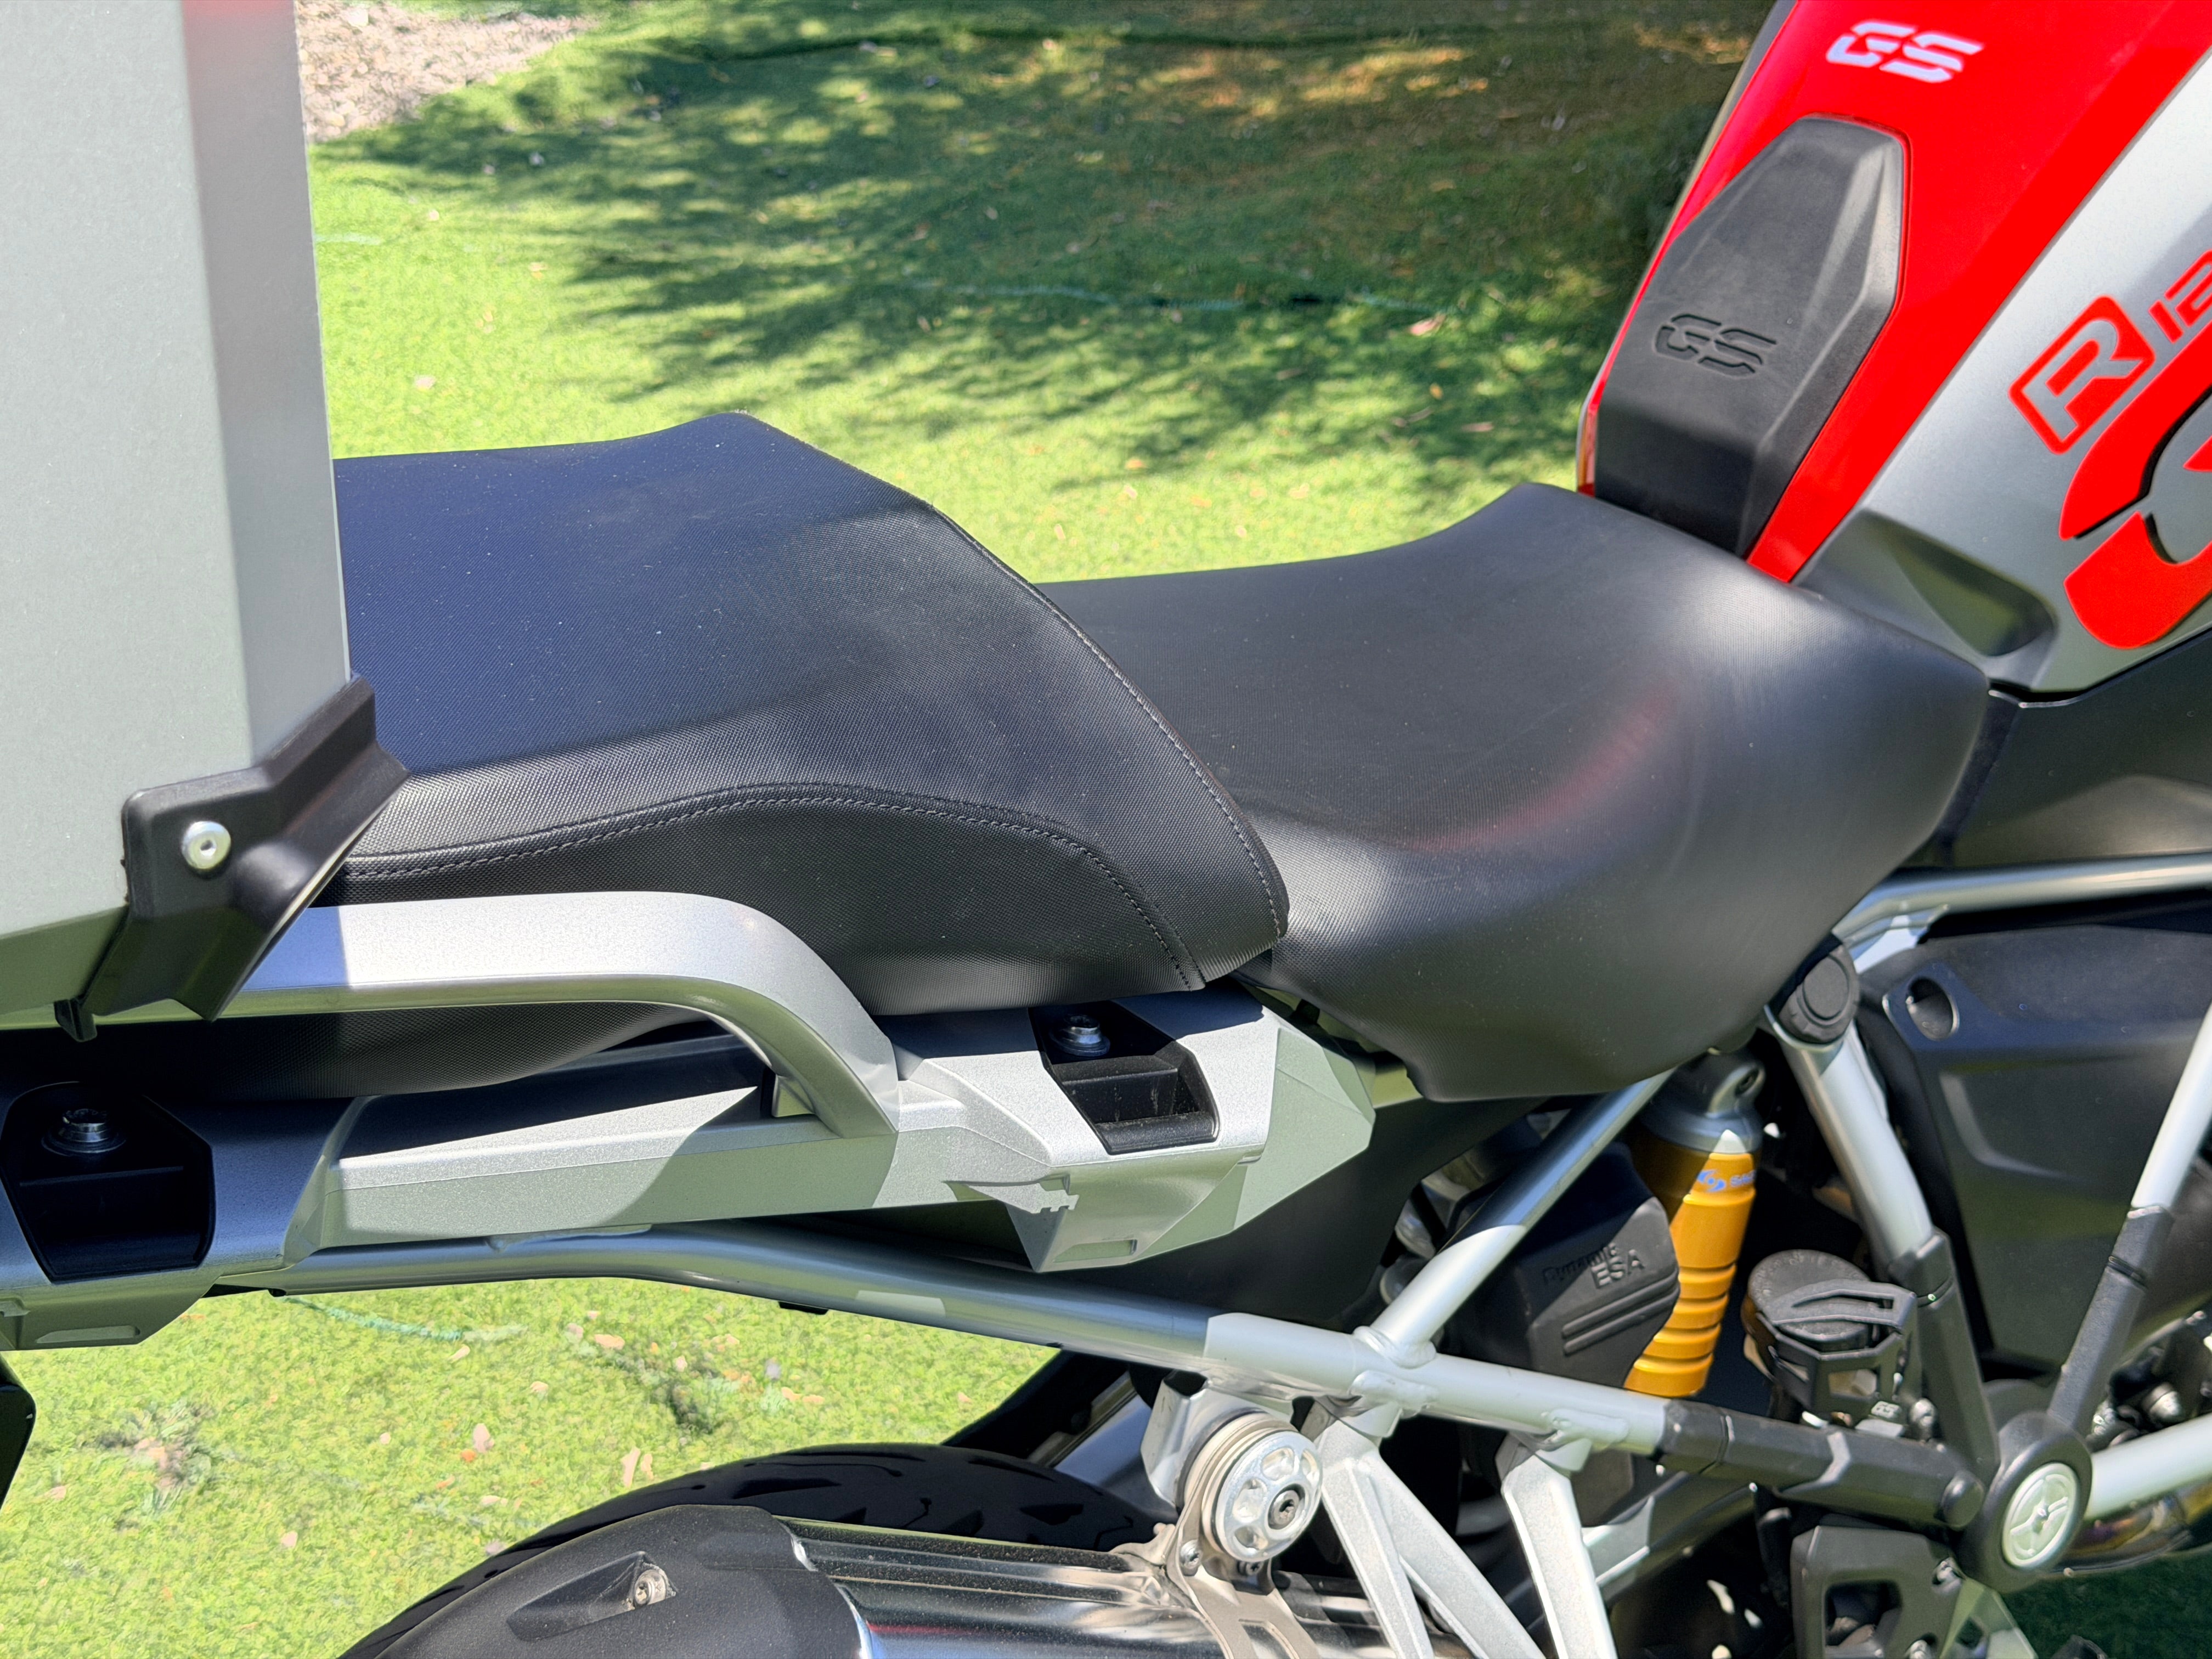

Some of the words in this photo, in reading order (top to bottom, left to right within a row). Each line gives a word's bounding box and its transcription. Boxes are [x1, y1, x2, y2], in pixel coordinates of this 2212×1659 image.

[1825, 21, 1985, 83] GS
[1653, 313, 1778, 379] GS
[1591, 1249, 1645, 1289] ESA
